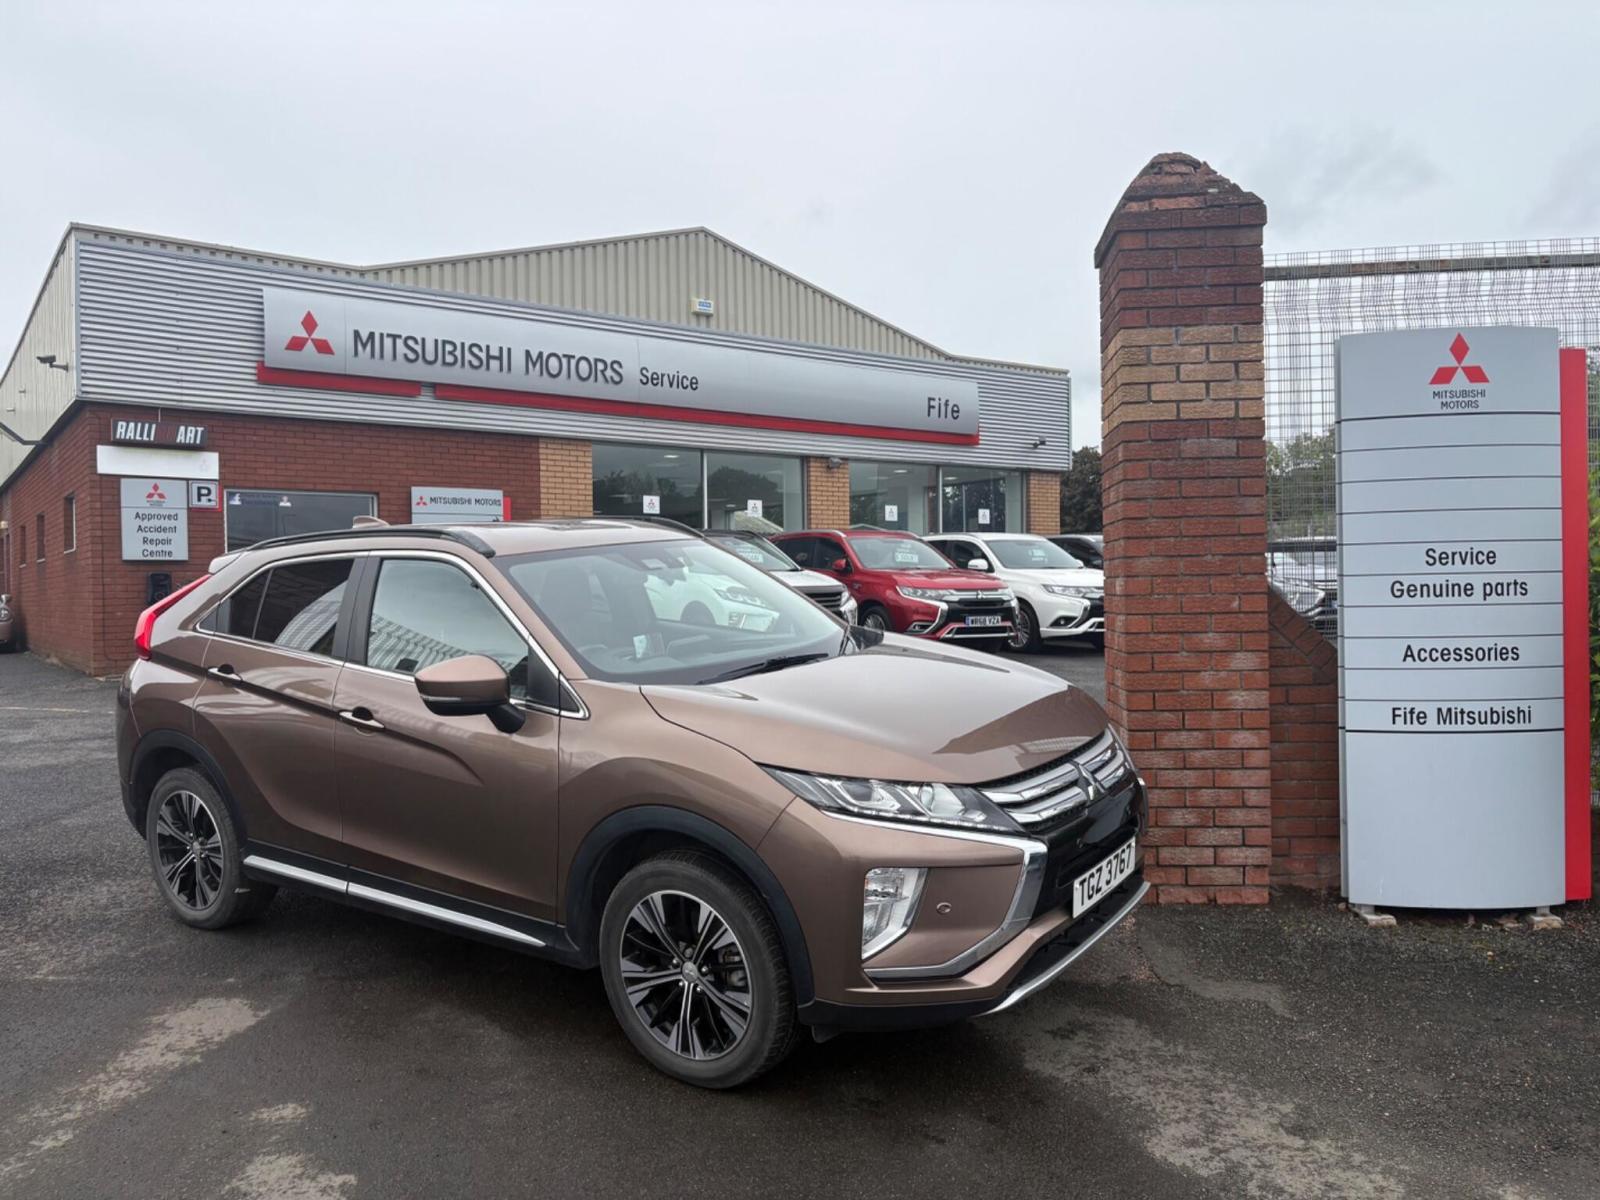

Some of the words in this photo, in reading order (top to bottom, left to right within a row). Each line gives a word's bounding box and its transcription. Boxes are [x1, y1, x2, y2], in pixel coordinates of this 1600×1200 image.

[352, 329, 512, 373] MITSUBISHI
[524, 349, 624, 385] MOTORS
[639, 367, 699, 391] Service
[1433, 389, 1486, 399] MITSUBISHI
[927, 397, 960, 420] Fife
[1441, 400, 1480, 410] MOTORS
[116, 421, 156, 441] RALLI
[176, 426, 204, 444] ART
[197, 486, 212, 502] P
[430, 496, 472, 505] MITSUBISHI
[475, 498, 501, 506] MOTORS
[135, 512, 178, 522] Approved
[137, 525, 177, 534] Accident
[142, 536, 172, 546] Repair
[142, 549, 173, 558] Centre
[1425, 547, 1497, 567] Service
[1390, 580, 1474, 598] Genuine
[1483, 579, 1528, 601] parts
[1402, 643, 1520, 662] Accessories
[1392, 707, 1427, 725] Fife
[1437, 705, 1532, 725] Mitsubishi
[1079, 865, 1103, 906] TGZ
[1105, 842, 1131, 886] 3767
